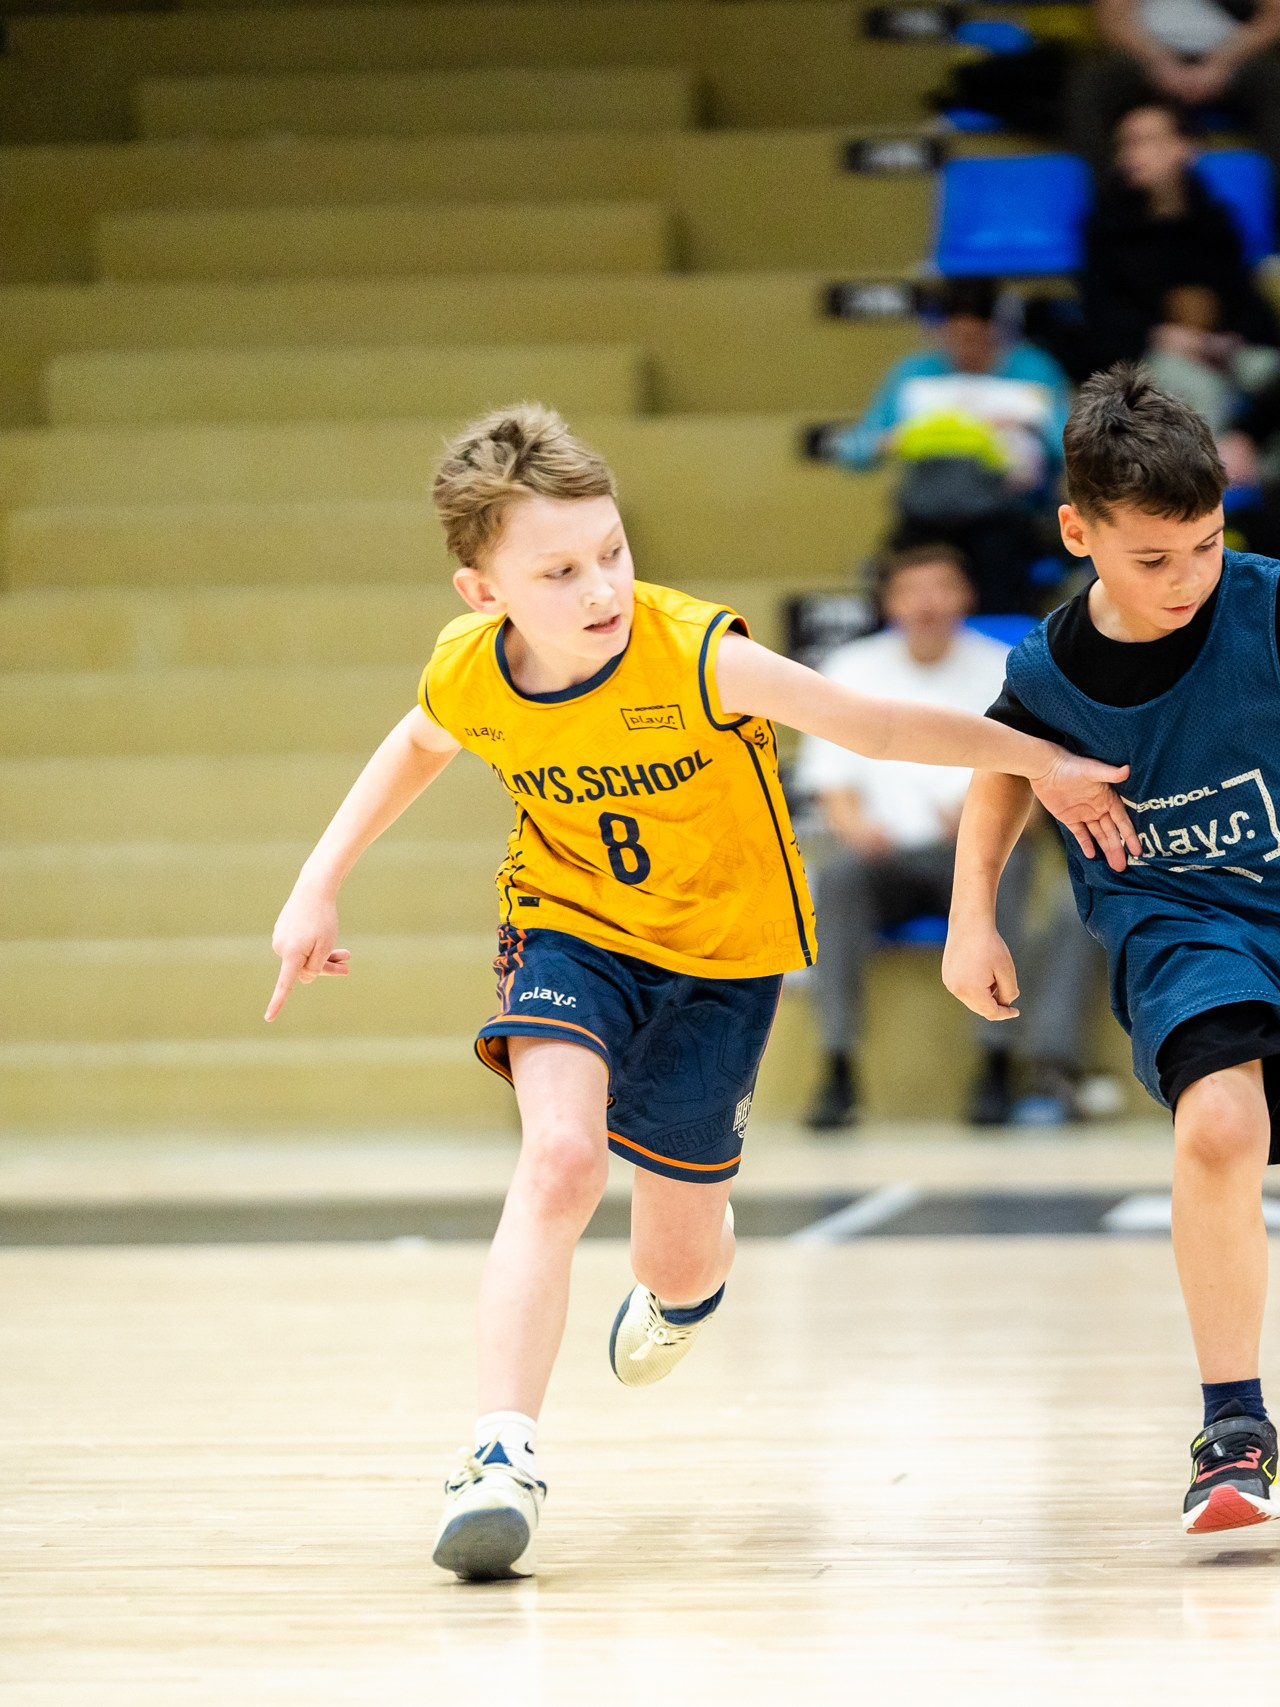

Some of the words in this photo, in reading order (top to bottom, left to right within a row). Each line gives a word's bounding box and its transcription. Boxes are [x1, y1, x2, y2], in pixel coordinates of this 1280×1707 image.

[1136, 786, 1218, 812] SCHOOL
[599, 811, 651, 885] 8
[519, 986, 577, 1008] plays.
